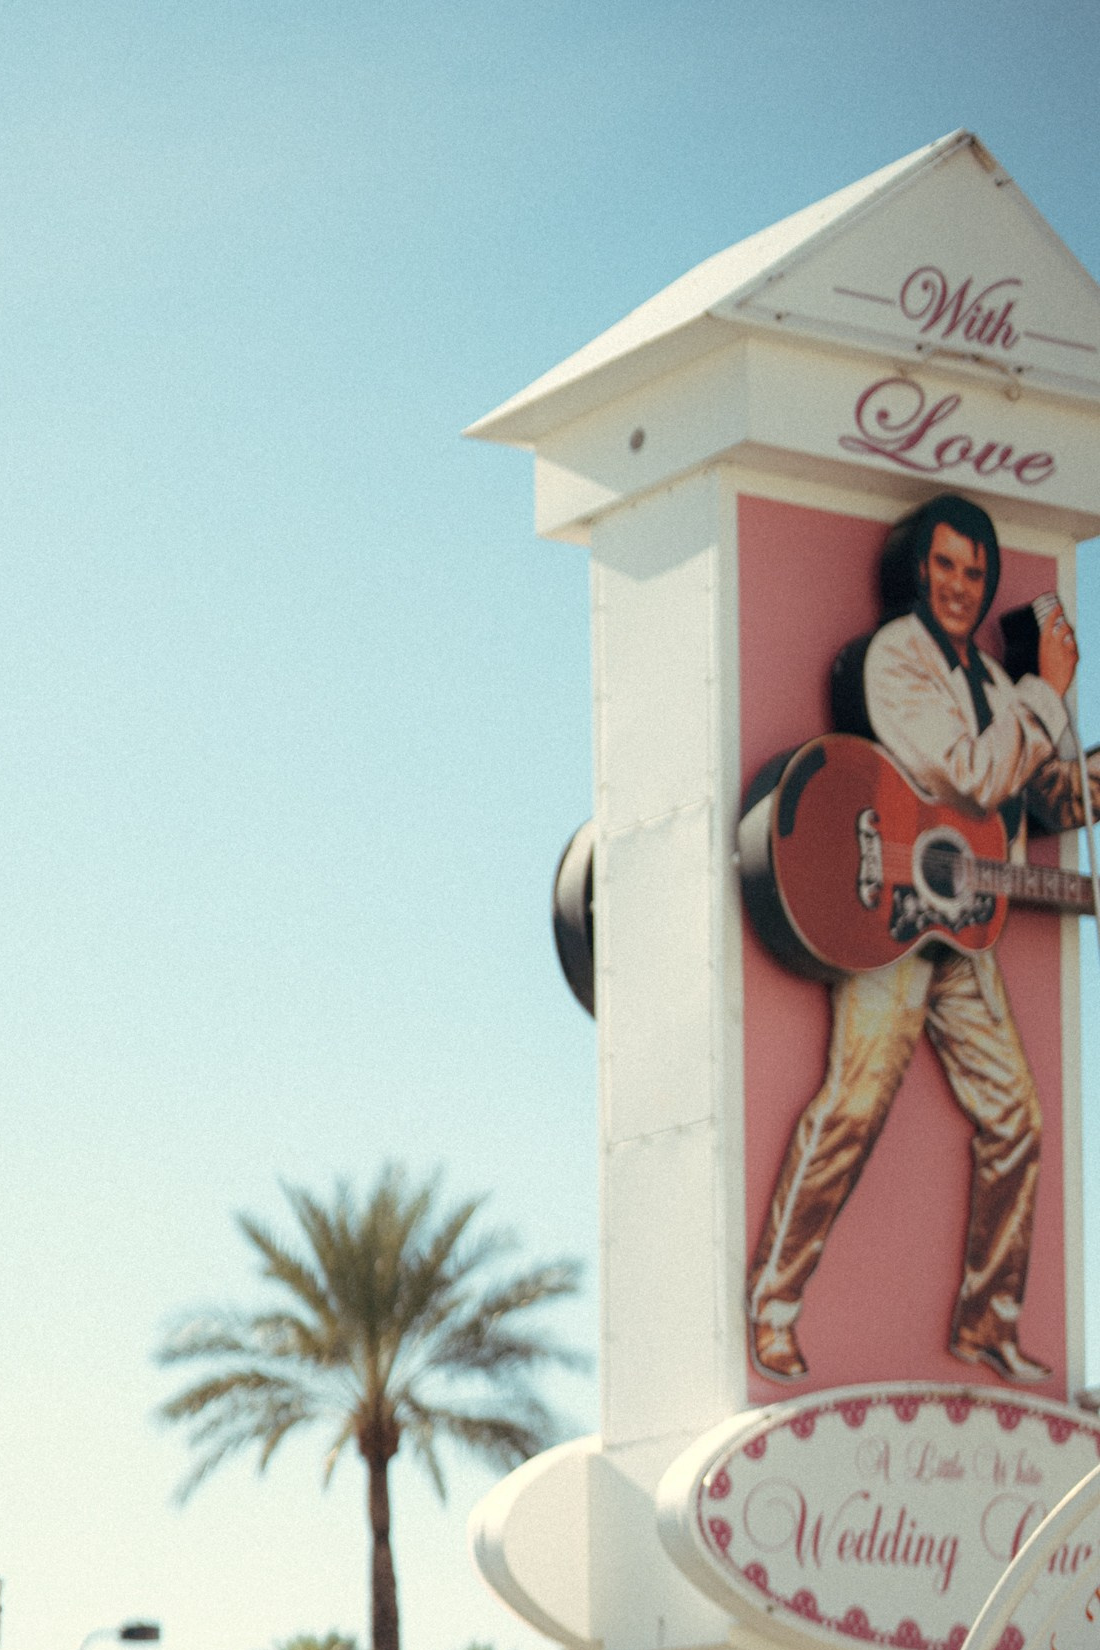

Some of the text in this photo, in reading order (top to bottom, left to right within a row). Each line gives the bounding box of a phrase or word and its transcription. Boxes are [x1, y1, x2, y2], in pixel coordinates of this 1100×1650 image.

[900, 265, 1022, 350] With
[838, 376, 1056, 486] Love
[743, 1477, 958, 1596] Wedding
